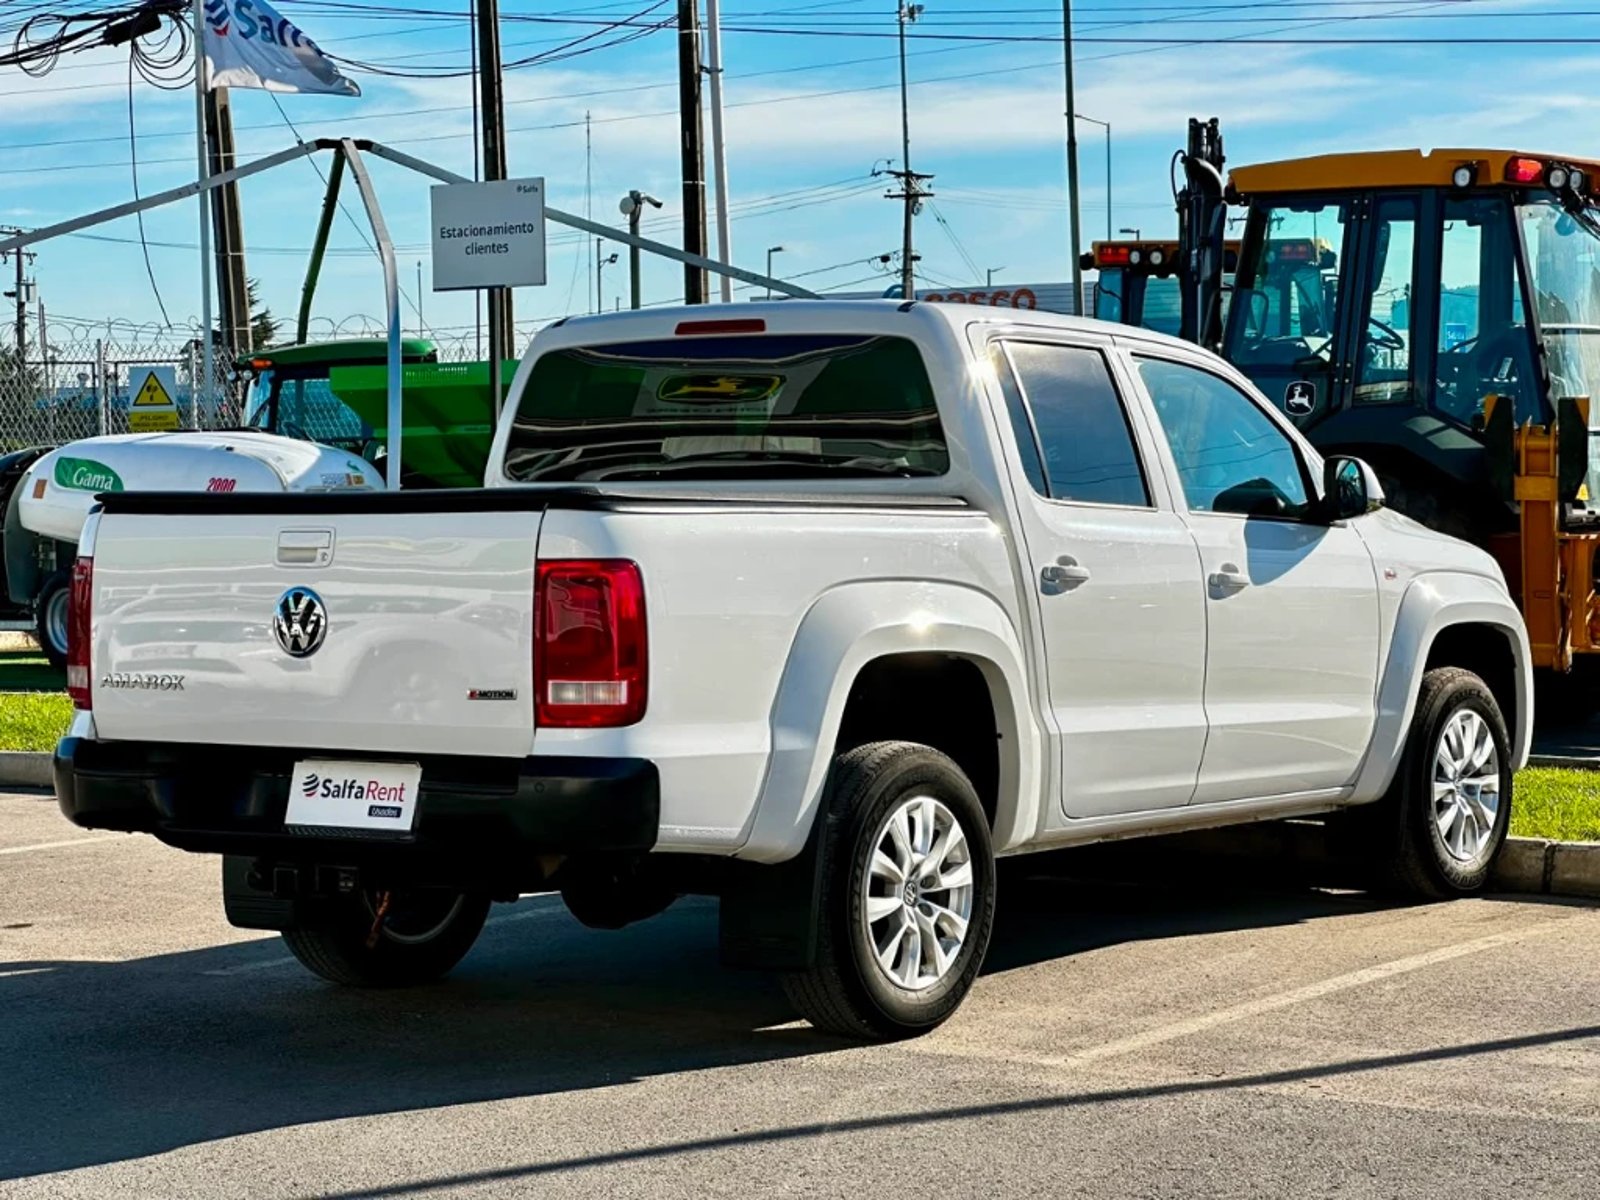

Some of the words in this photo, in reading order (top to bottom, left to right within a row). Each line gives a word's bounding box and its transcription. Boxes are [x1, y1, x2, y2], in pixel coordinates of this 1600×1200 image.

[440, 222, 534, 239] Estacionamiento
[465, 242, 509, 256] clientes
[72, 466, 115, 491] Gama
[206, 477, 237, 492] 2000
[100, 672, 186, 691] AMAROK
[321, 777, 406, 802] SalfaRent
